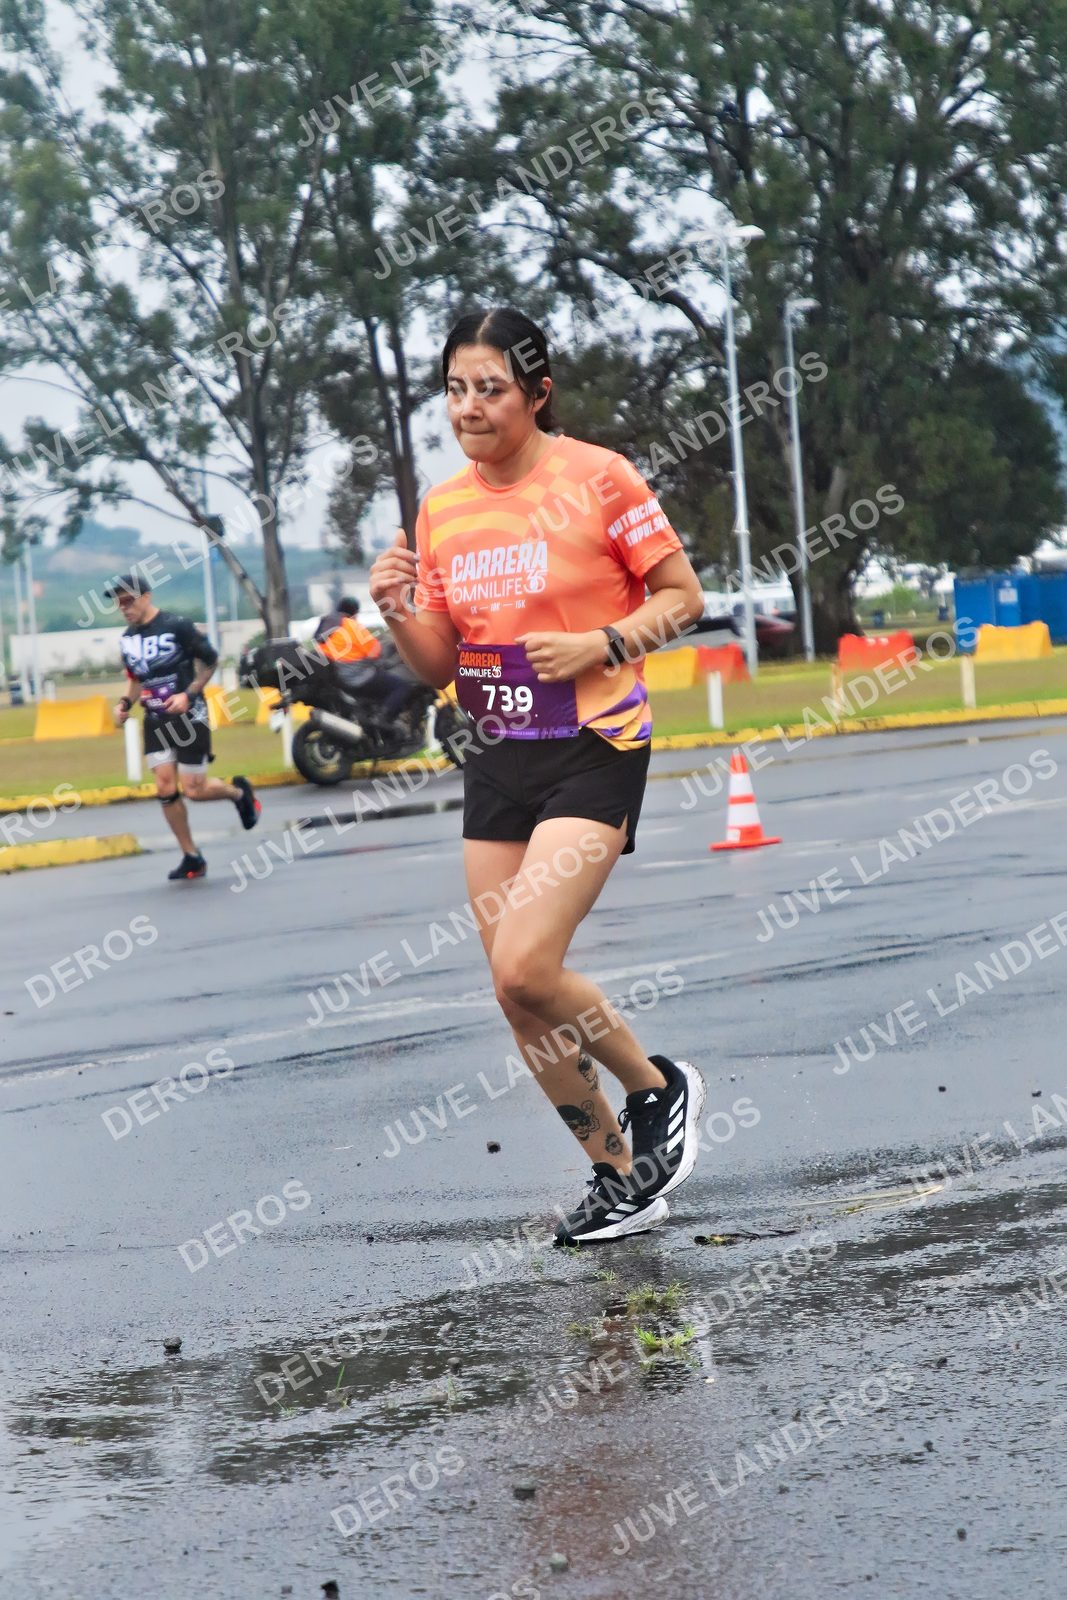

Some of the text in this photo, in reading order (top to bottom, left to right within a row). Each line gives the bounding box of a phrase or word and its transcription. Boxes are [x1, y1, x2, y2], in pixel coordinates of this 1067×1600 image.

[451, 541, 548, 584] CARRERA
[452, 577, 523, 605] OMNILIFE
[459, 651, 501, 667] CARRERA
[459, 667, 492, 678] OMNILIFE
[482, 685, 534, 713] 739
